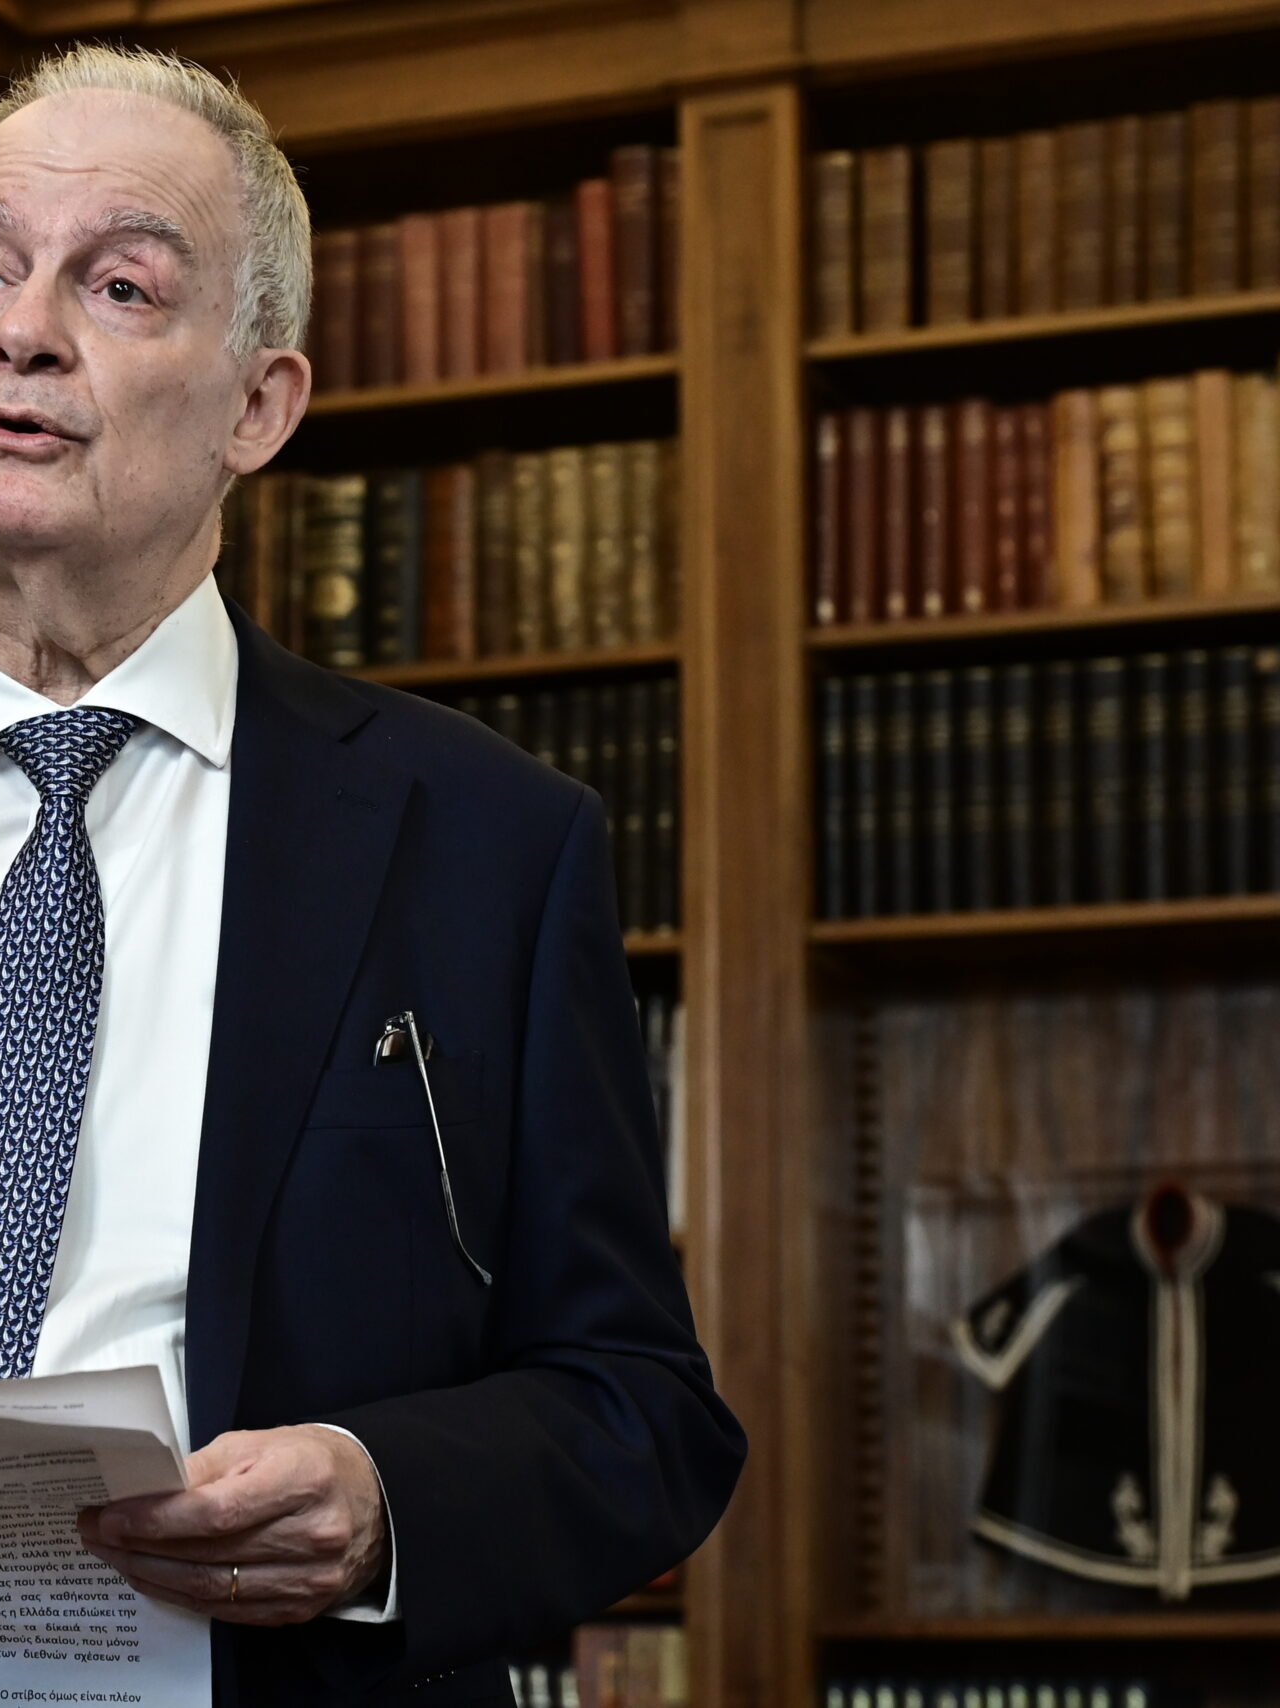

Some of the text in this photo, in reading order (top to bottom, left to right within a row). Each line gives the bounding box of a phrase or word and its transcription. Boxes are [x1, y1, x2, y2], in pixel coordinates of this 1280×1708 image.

[22, 1550, 50, 1558] αλλά
[53, 1550, 71, 1559] την
[14, 1579, 35, 1587] που
[56, 1576, 94, 1586] κάνατε
[21, 1593, 41, 1602] σας
[50, 1591, 109, 1602] καθήκοντα
[9, 1609, 17, 1618] η
[20, 1607, 60, 1617] Ελλάδα
[63, 1607, 115, 1617] επιδιώκει
[118, 1608, 137, 1618] την
[46, 1622, 81, 1632] δίκαιά
[89, 1625, 108, 1633] της
[116, 1625, 138, 1633] που
[35, 1635, 79, 1646] δικαίου,
[82, 1638, 103, 1647] που
[106, 1638, 139, 1648] μόνον
[23, 1649, 67, 1660] διεθνών
[74, 1651, 121, 1663] σχέσεων
[0, 1690, 9, 1700] Ο
[11, 1689, 47, 1701] στίβος
[49, 1690, 78, 1702] όμως
[80, 1691, 107, 1701] είναι
[109, 1691, 141, 1703] πλέον
